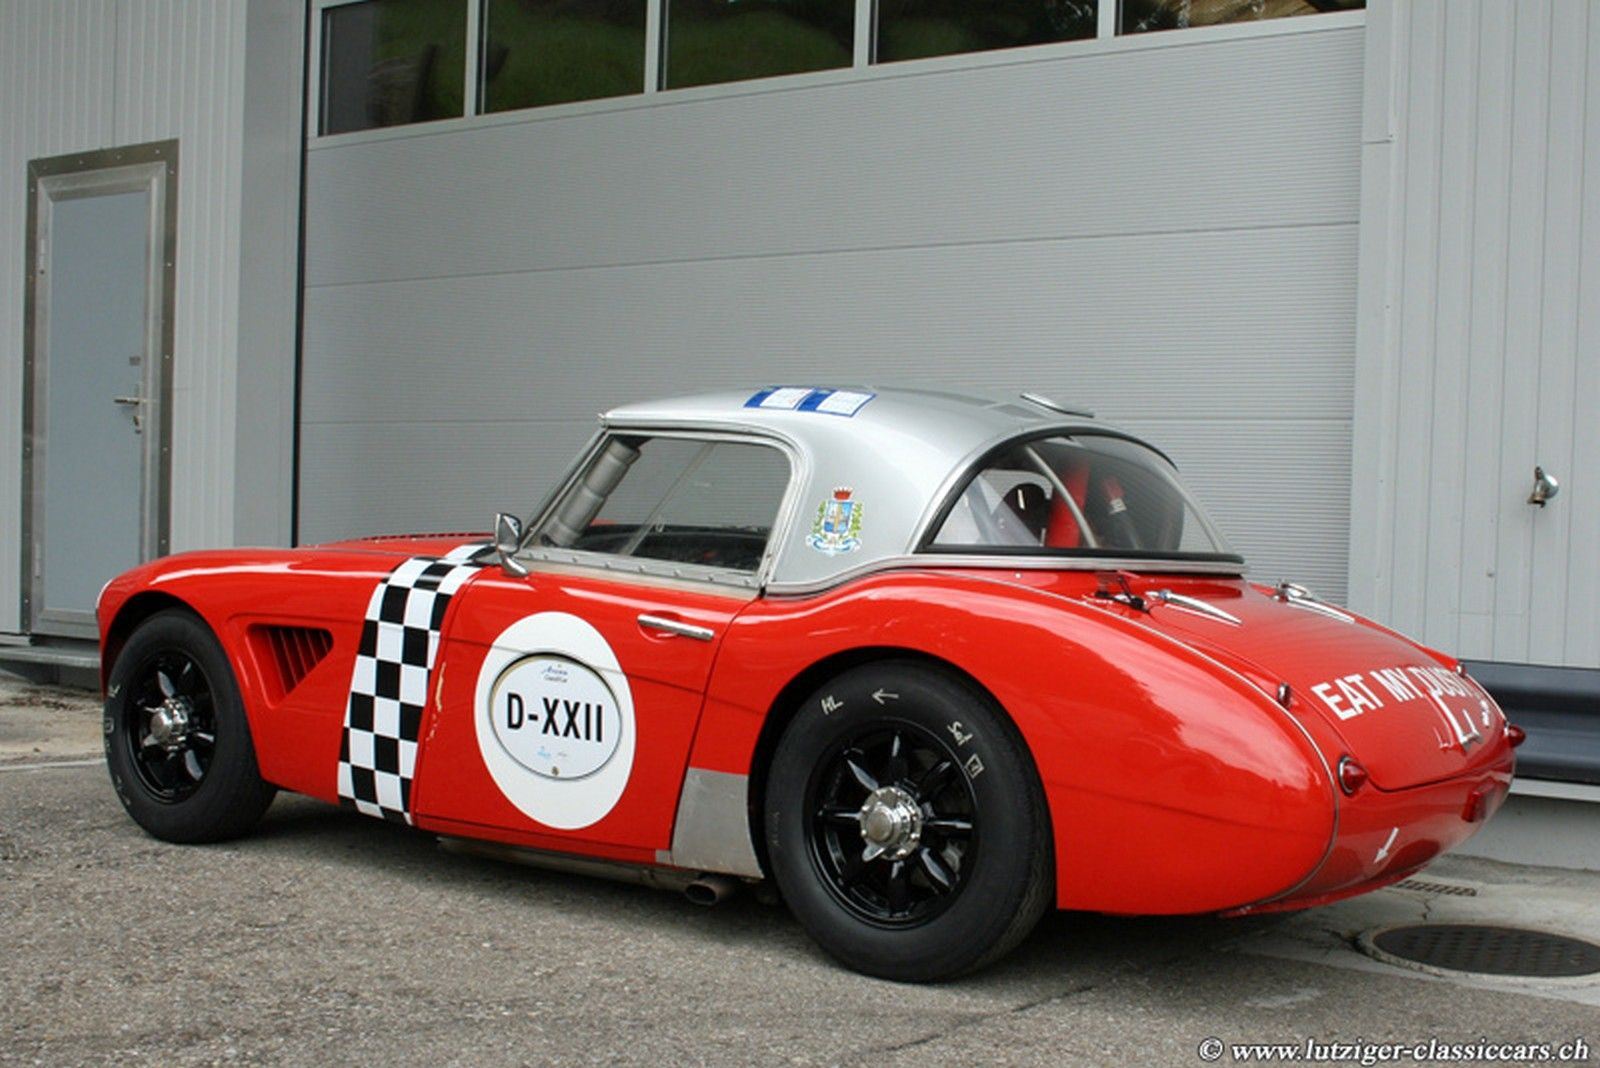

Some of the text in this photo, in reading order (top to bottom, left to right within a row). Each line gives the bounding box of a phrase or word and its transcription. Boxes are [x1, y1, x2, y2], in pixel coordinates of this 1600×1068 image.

[507, 692, 602, 742] D-XXII
[1310, 673, 1384, 720] EAT
[1369, 667, 1424, 702] MY
